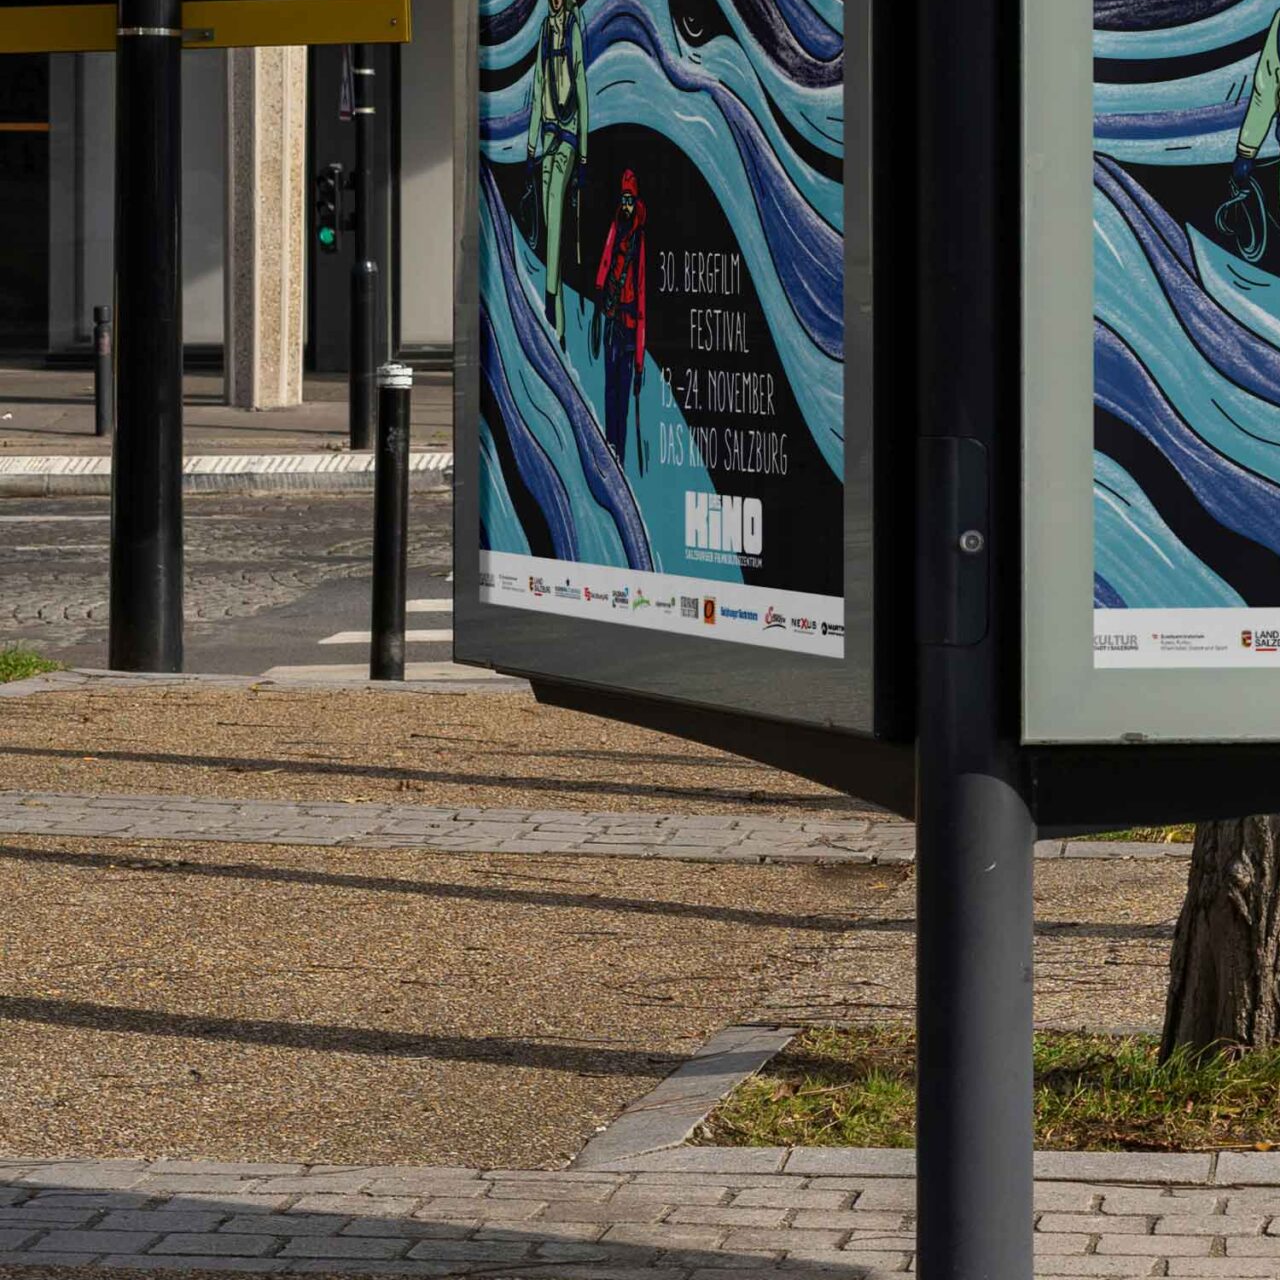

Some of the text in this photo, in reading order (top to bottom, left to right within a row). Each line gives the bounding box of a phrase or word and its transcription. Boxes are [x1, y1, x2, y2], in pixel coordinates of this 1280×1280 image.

[659, 251, 740, 294] 30. BERGFILM
[690, 308, 749, 353] FESTIVAL
[708, 369, 775, 415] NOVEMBER
[660, 422, 788, 475] DAS KINO SALZBURG
[1255, 630, 1279, 639] LAND
